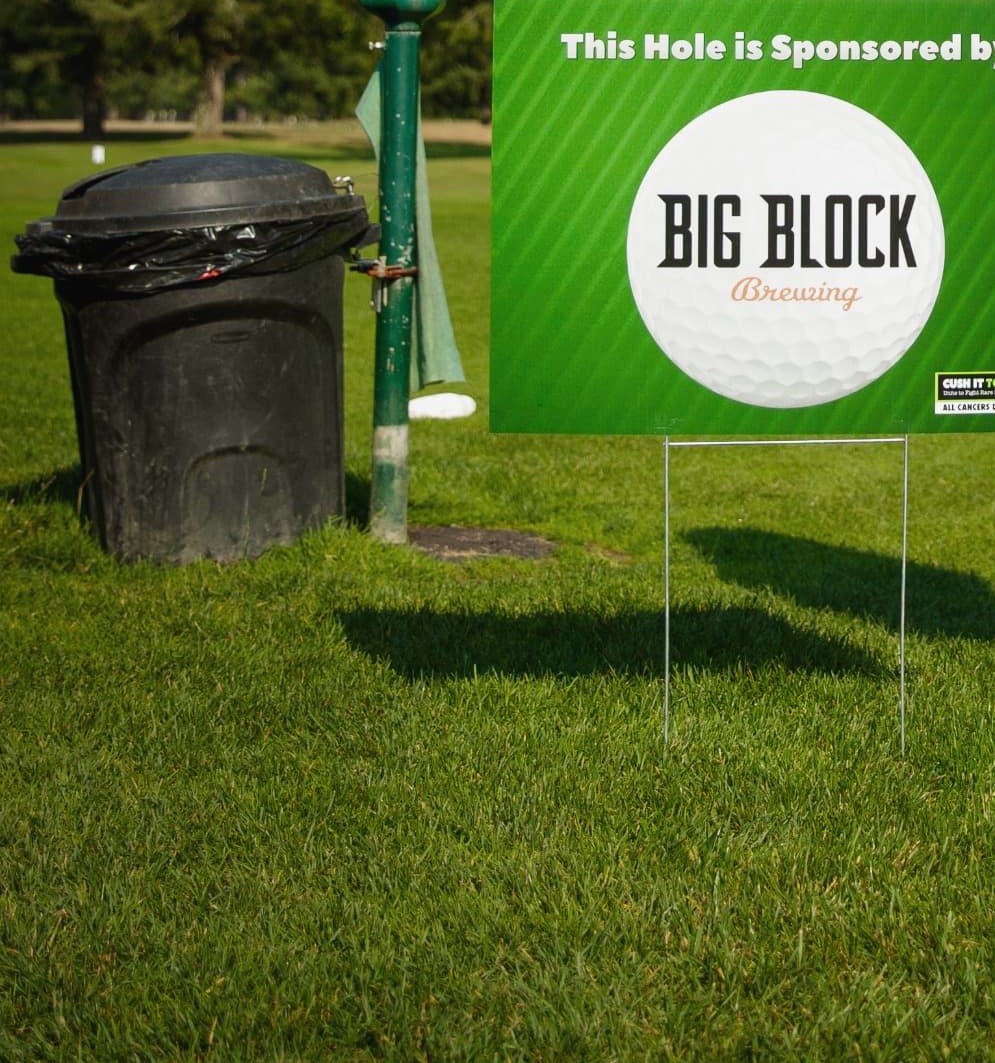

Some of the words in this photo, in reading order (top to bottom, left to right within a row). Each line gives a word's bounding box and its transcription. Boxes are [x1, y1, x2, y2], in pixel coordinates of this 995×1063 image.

[560, 31, 635, 60] This
[644, 32, 726, 60] Hole
[734, 31, 763, 60] is
[770, 34, 962, 69] Sponsored
[656, 194, 742, 268] BIG
[759, 194, 918, 268] BLOCK
[730, 276, 862, 312] Brewing
[942, 378, 972, 389] CUSH
[973, 378, 984, 388] IT
[957, 403, 990, 411] CANCERS
